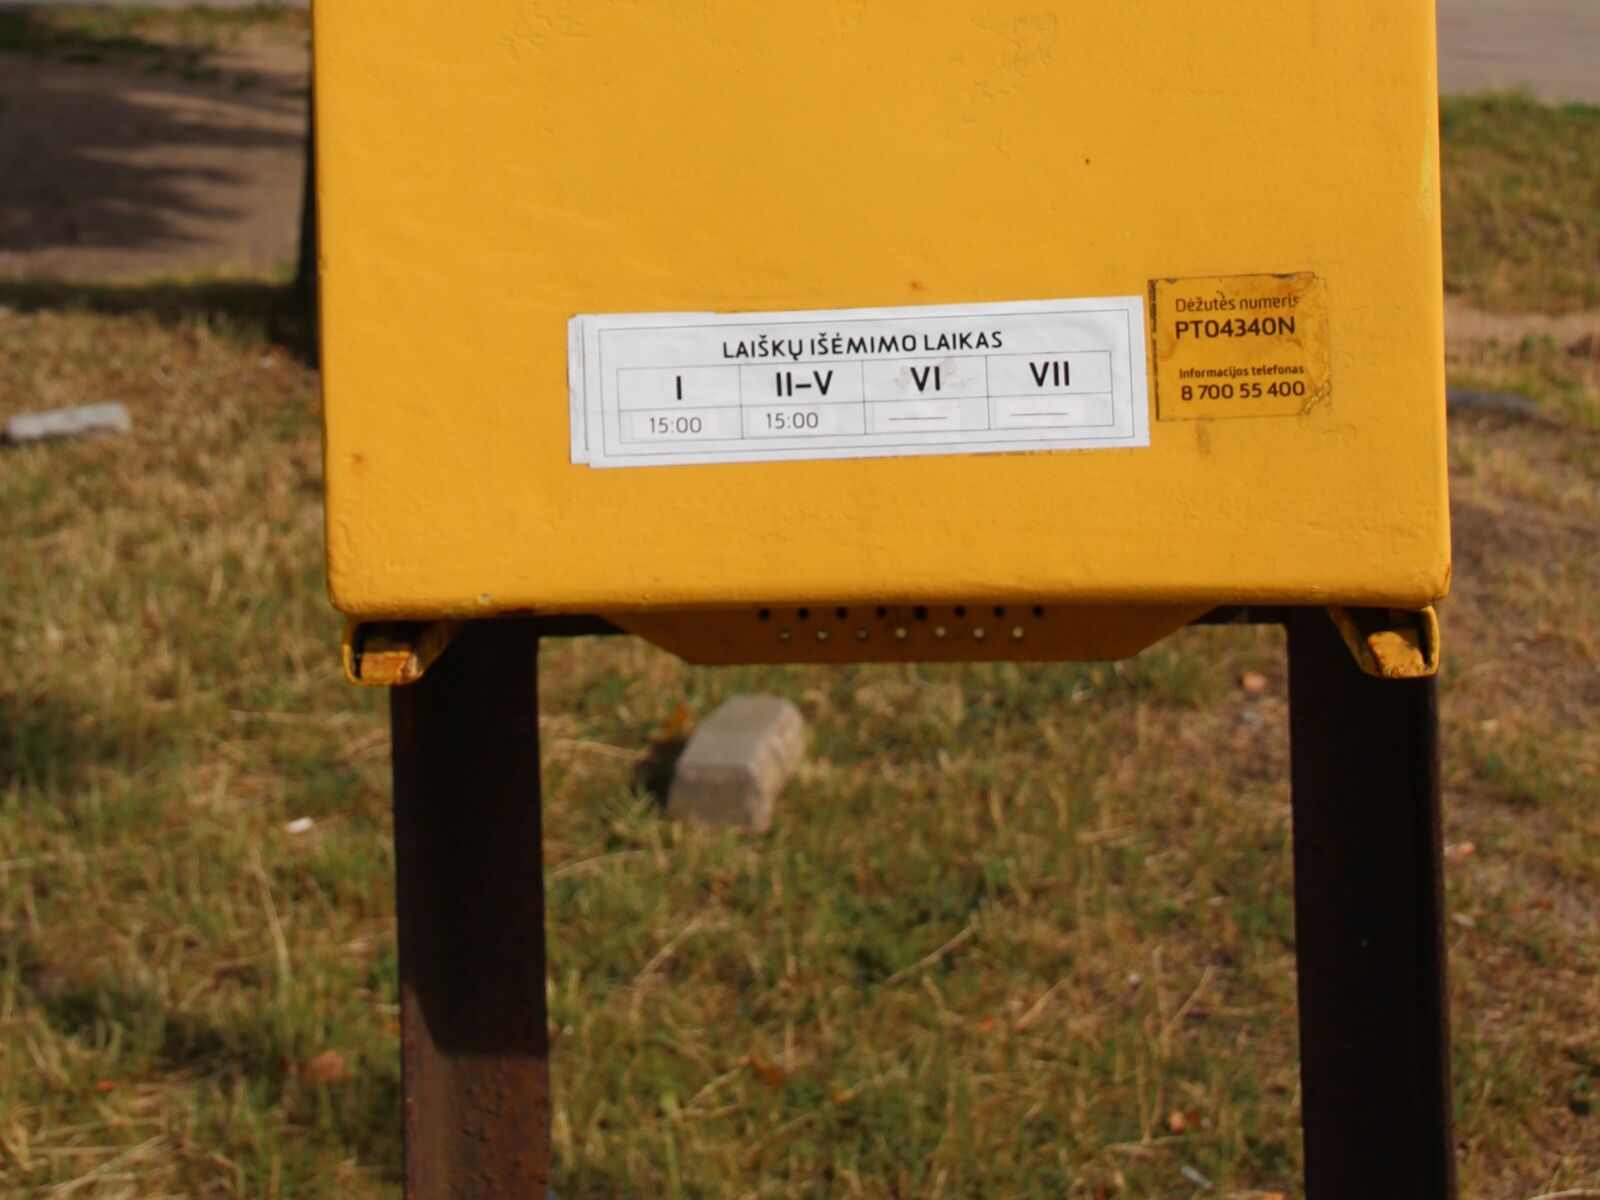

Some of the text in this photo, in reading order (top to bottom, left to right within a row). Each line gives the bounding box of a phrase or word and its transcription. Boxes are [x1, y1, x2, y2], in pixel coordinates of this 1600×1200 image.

[1175, 294, 1300, 313] Dėžutės numeris
[723, 331, 1003, 361] LAIŠKŲ IŠĖMIMO LAIKAS
[910, 366, 941, 392] VI
[1029, 361, 1070, 387] VII
[1179, 364, 1304, 379] Informacijos telefonas
[1181, 381, 1305, 401] 8 700 55 400
[650, 412, 819, 434] 15:00 15:00
